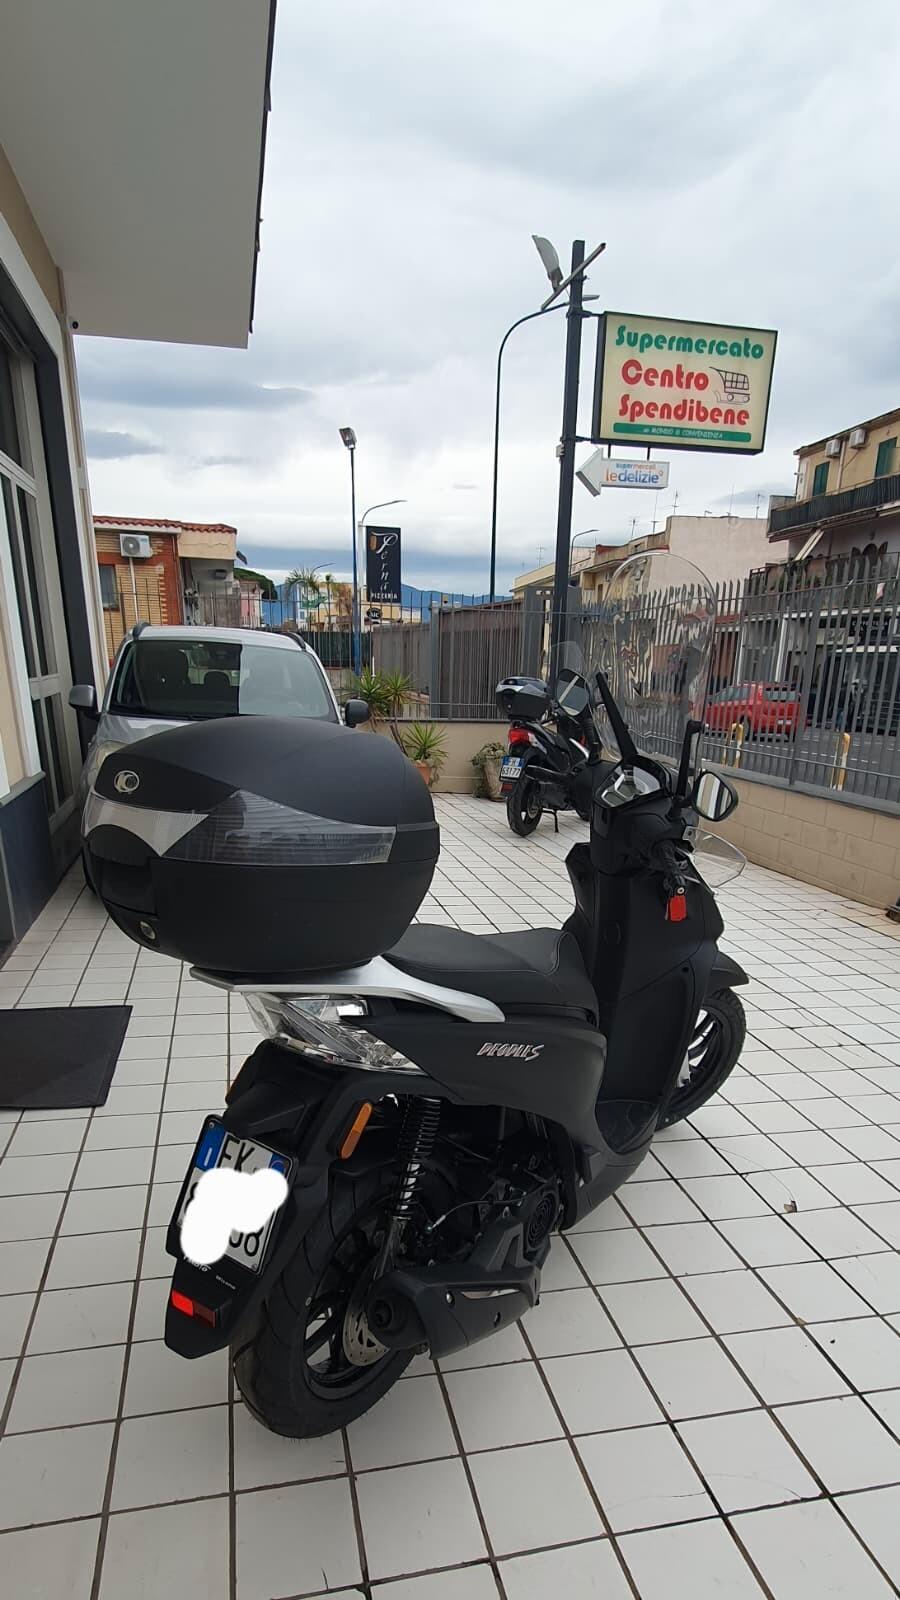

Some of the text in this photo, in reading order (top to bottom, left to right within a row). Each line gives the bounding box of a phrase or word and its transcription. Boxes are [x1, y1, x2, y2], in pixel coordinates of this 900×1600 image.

[615, 324, 764, 359] Supermercato
[621, 359, 709, 391] Centro
[618, 394, 750, 426] Spendibene
